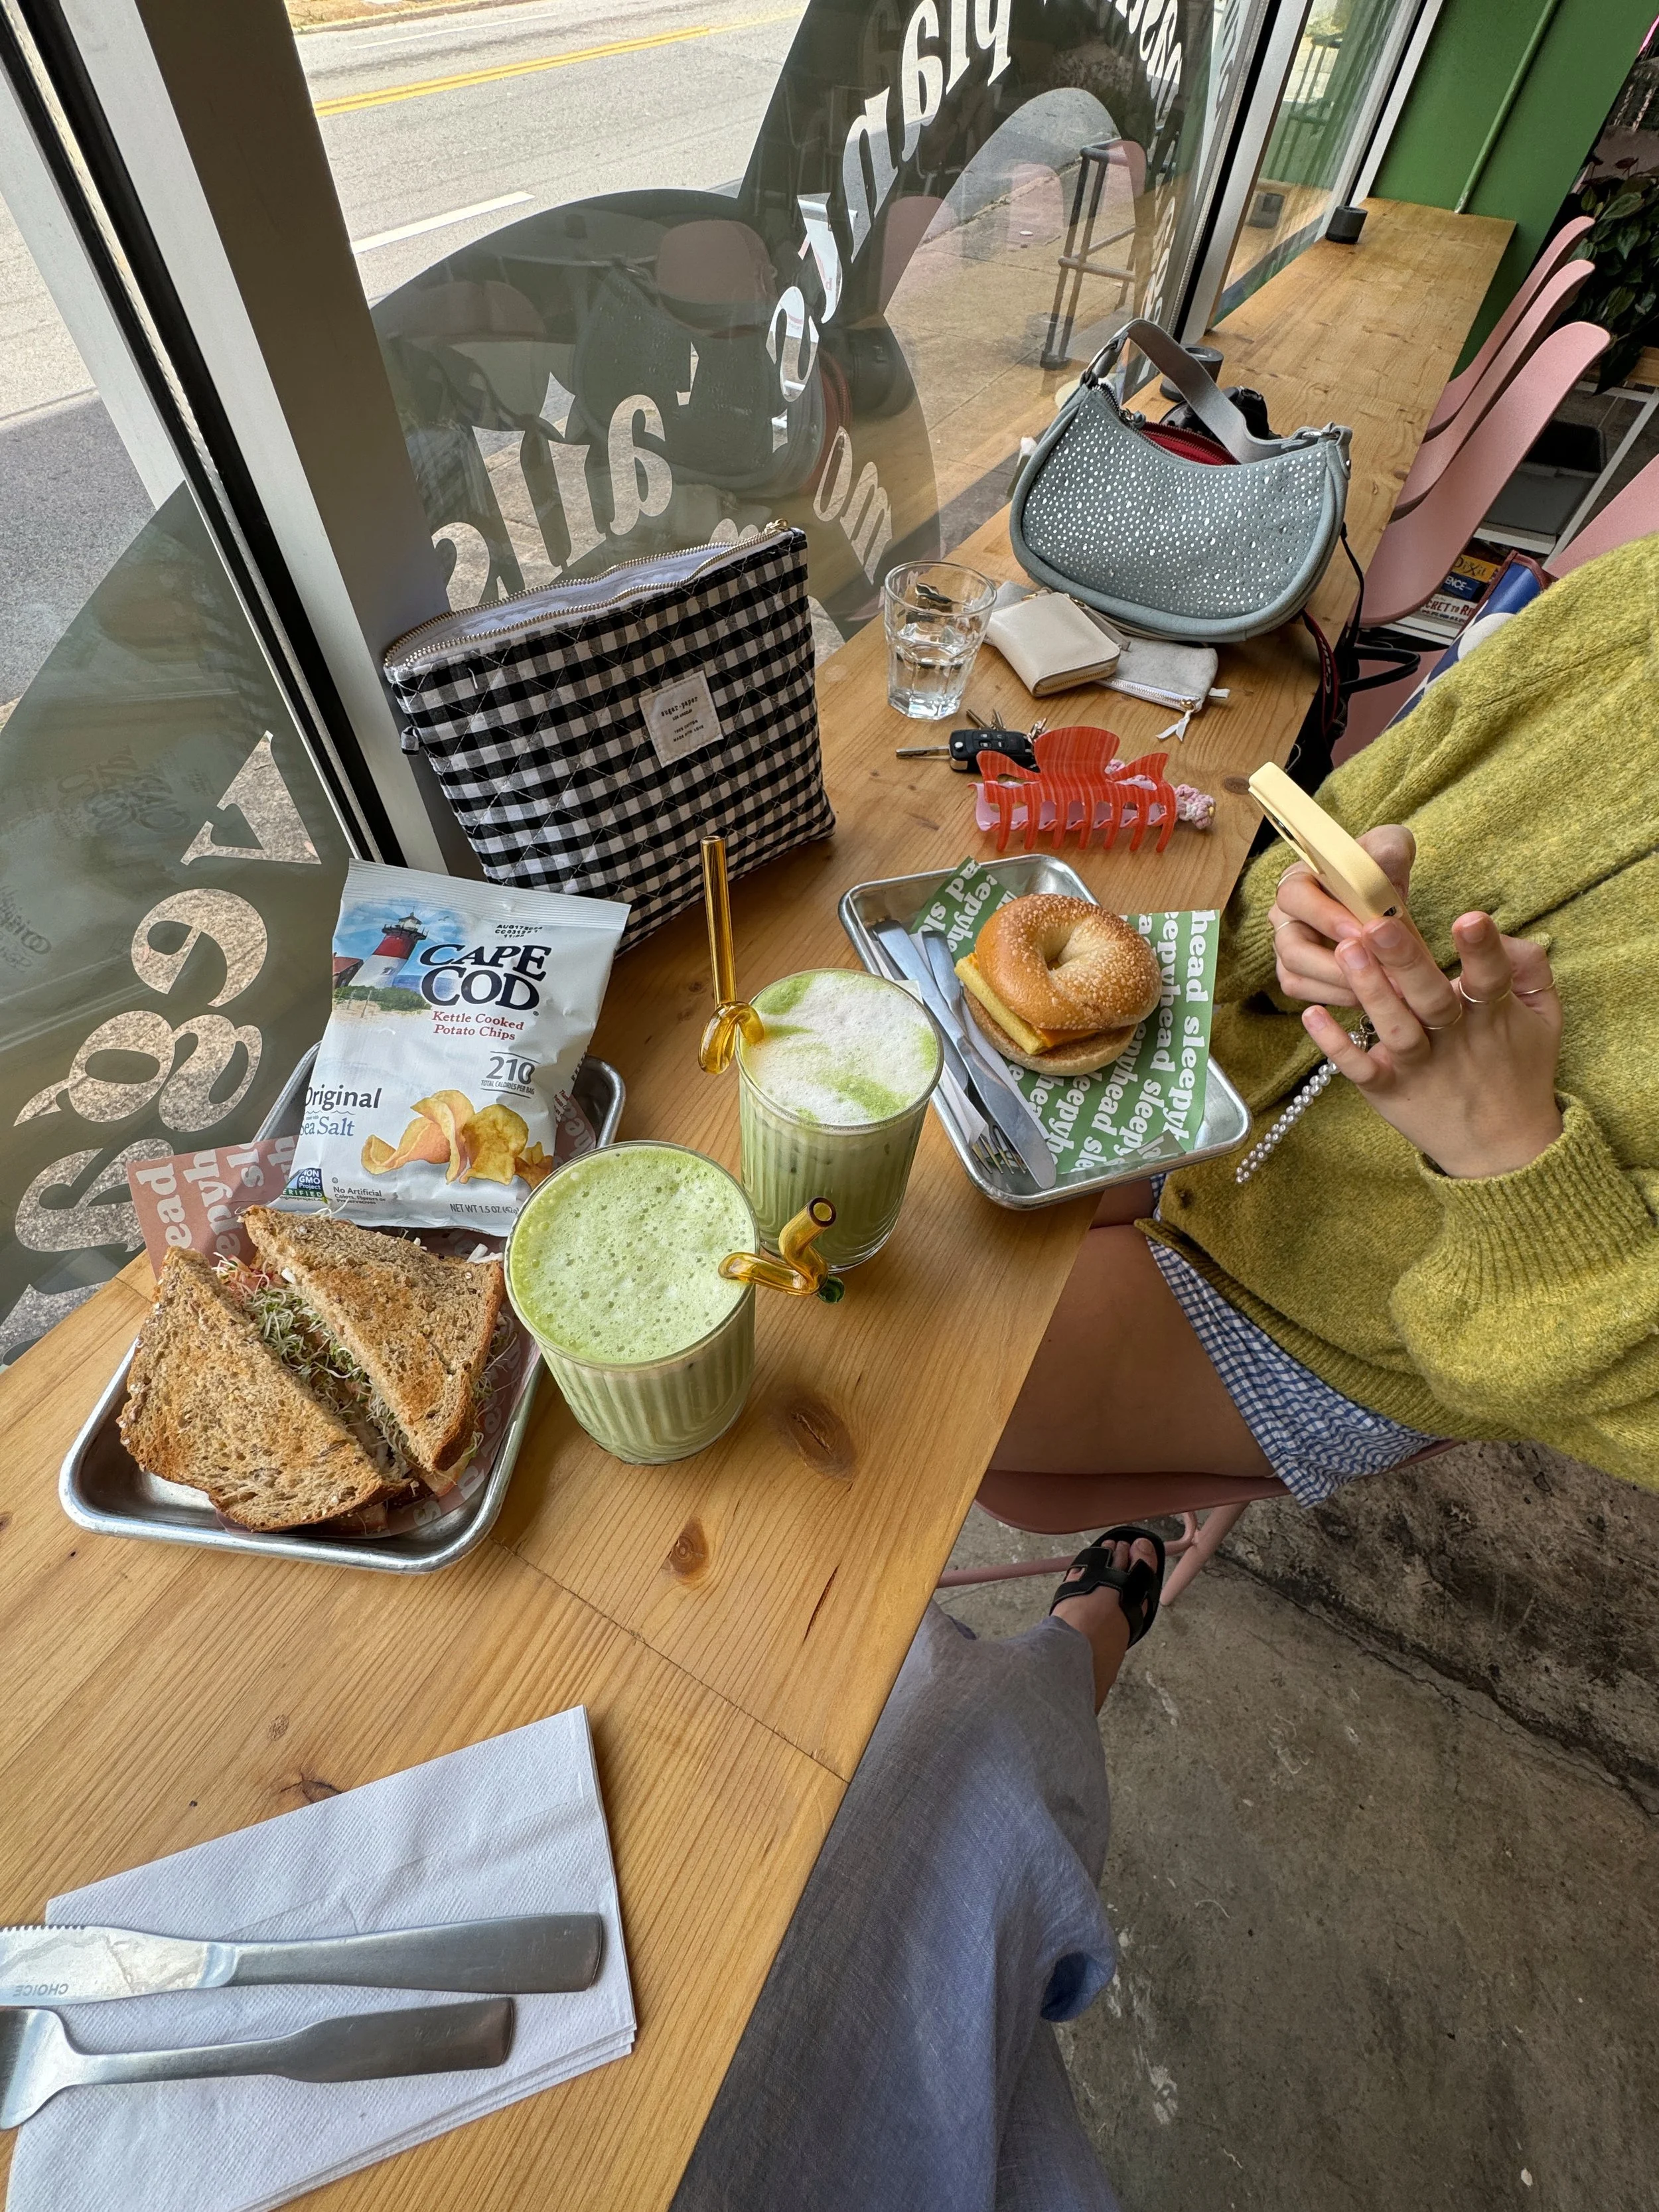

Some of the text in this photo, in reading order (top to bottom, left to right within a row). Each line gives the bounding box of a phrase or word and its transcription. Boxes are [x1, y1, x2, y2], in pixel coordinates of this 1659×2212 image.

[419, 944, 552, 982] CAPE
[421, 966, 540, 1011] COD
[431, 1011, 525, 1031] Kettle Cooked
[433, 1023, 516, 1041] Potato Chips
[486, 1056, 536, 1085] 210
[495, 1080, 518, 1090] CALORIES
[525, 1086, 535, 1095] BAG
[317, 1116, 355, 1136] Salt
[299, 1176, 321, 1185] GMO
[299, 1182, 321, 1191] Project
[347, 1187, 382, 1197] Artificial
[449, 1203, 465, 1213] NET
[465, 1204, 478, 1213] WT
[12, 1982, 69, 1997] CHOICE
